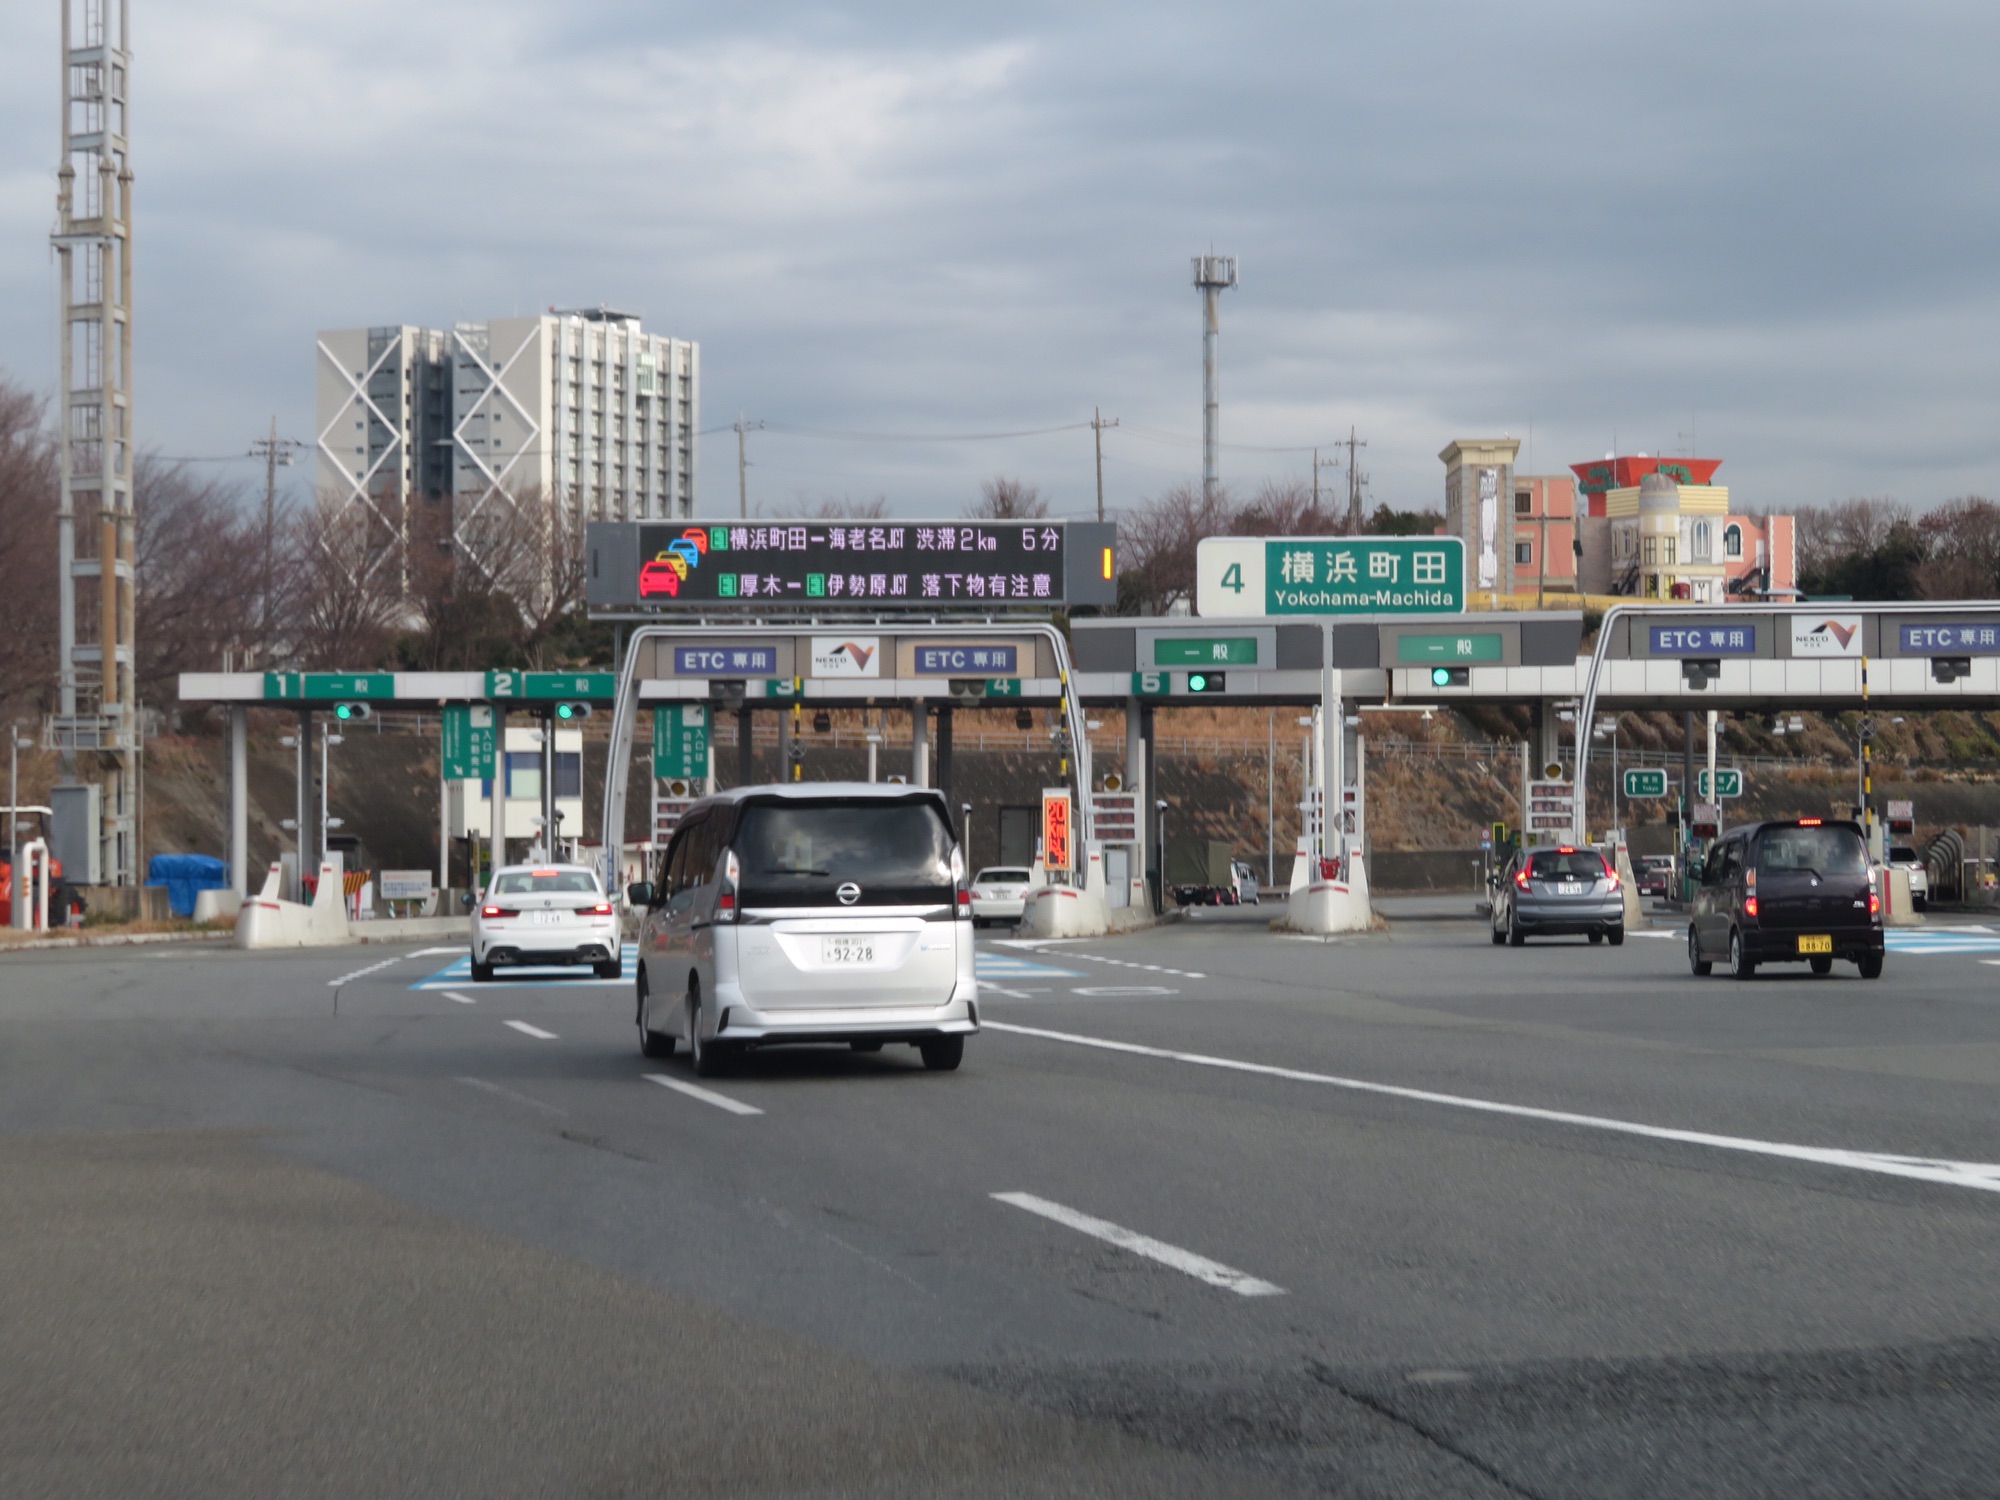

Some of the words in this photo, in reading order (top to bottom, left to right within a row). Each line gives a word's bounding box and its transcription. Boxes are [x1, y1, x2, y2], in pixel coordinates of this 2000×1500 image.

[1022, 527, 1059, 551] 5分
[1280, 550, 1447, 584] 横浜町田
[827, 573, 908, 597] 伊勢原JCT
[921, 573, 1051, 597] 落下物有注意
[1220, 563, 1246, 594] 4
[1274, 589, 1454, 607] Yokohama-Machida
[1660, 630, 1701, 648] ETC
[1709, 631, 1744, 648] 専用
[1909, 628, 1952, 647] ETC
[1960, 628, 1995, 646] 専用
[1184, 643, 1228, 660] 一般
[1428, 639, 1472, 655] 一般
[684, 652, 725, 669] ETC
[733, 652, 766, 669] 専用
[924, 652, 965, 668] ETC
[973, 651, 1007, 667] 専用
[276, 674, 287, 697] 1
[494, 673, 513, 696] 2
[775, 679, 794, 695] 3
[993, 679, 1011, 694] 4
[1141, 672, 1160, 693] 5
[1048, 801, 1065, 821] 20
[834, 946, 873, 961] 92-28
